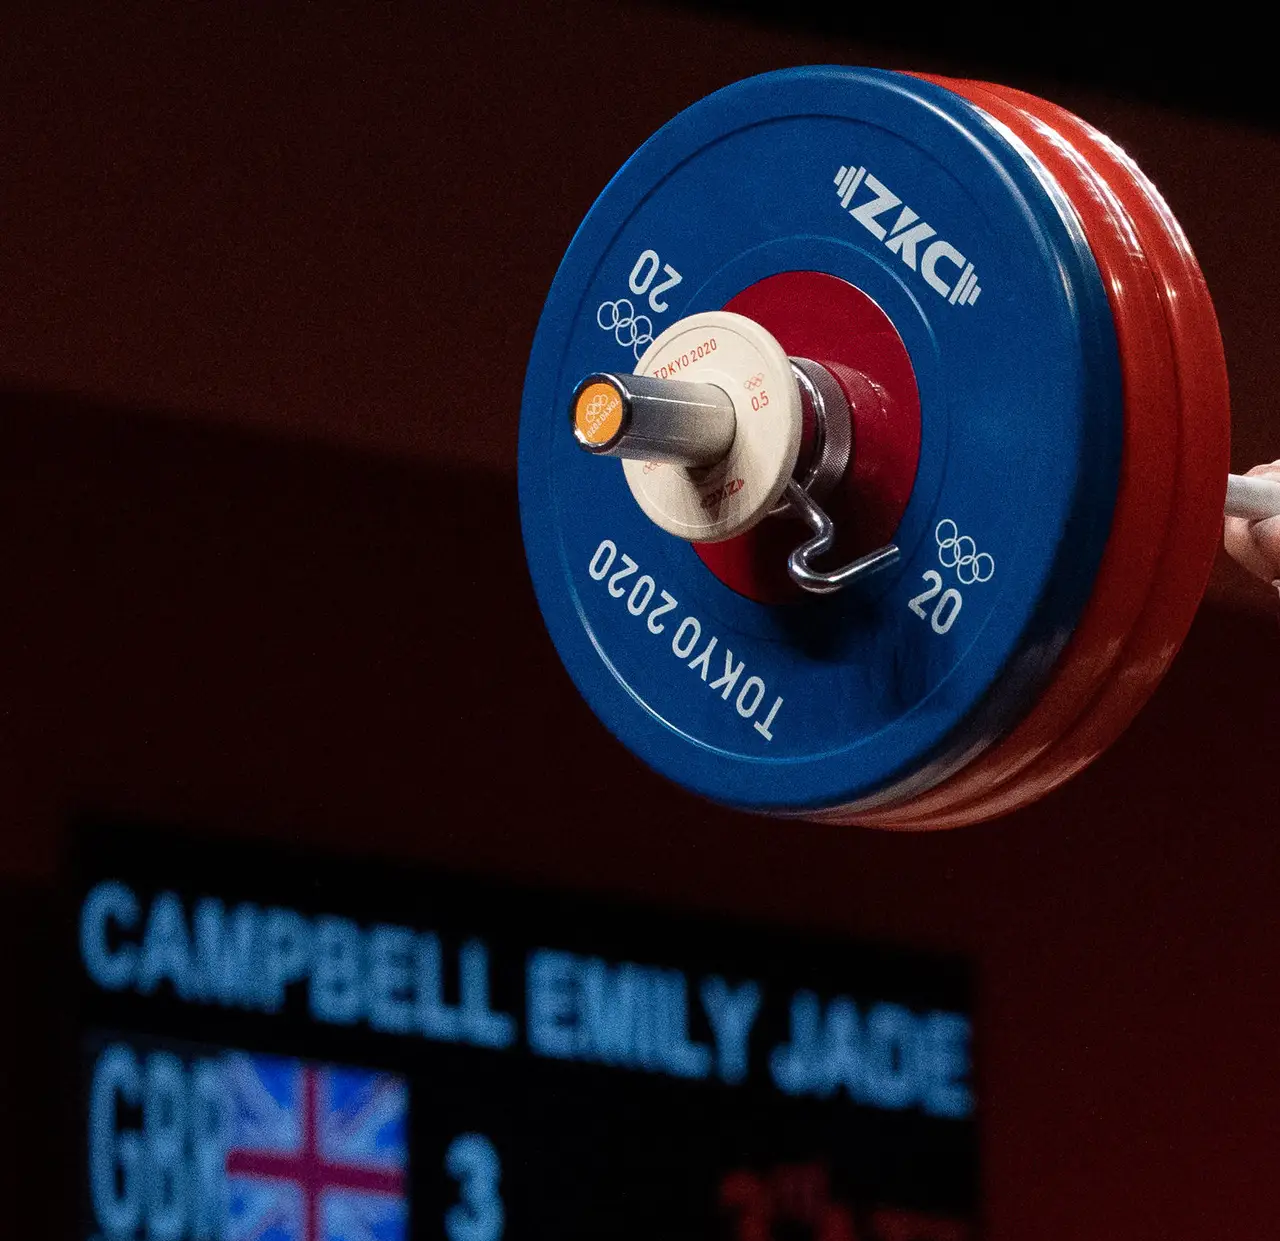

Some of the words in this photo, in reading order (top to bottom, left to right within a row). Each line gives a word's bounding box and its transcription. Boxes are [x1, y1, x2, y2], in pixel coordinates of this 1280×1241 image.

[845, 171, 968, 299] ZKC
[628, 250, 683, 313] 20
[652, 355, 689, 380] TOKYO
[690, 338, 718, 363] 2020
[751, 390, 769, 412] 0.5
[907, 570, 964, 636] 20
[588, 539, 678, 635] 2020
[669, 613, 785, 741] TOKYO
[80, 883, 515, 1049] CAMPBELL
[527, 948, 760, 1082] EMILY
[770, 990, 977, 1118] JADE
